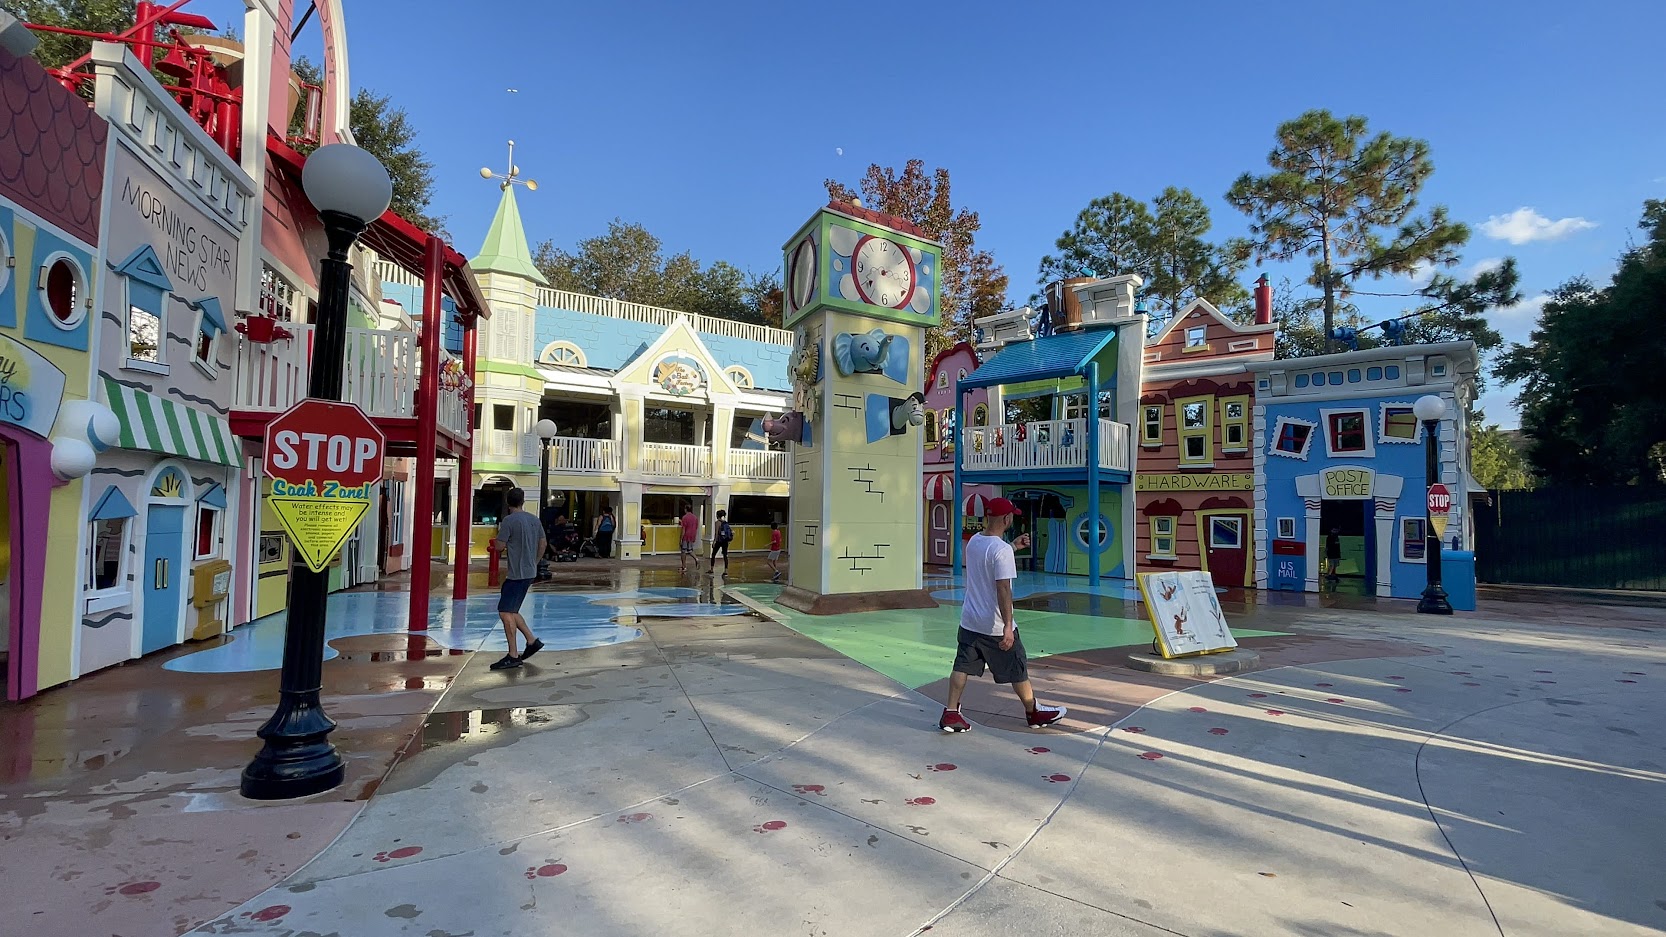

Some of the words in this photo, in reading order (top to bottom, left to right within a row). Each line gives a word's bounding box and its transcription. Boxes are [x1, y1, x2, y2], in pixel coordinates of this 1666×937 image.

[121, 176, 196, 254] MORNING
[198, 234, 232, 280] STAR
[880, 242, 888, 252] 12
[166, 241, 207, 292] NEWS
[857, 261, 864, 273] 9
[903, 271, 909, 282] 3
[881, 293, 888, 306] 6
[273, 430, 378, 473] STOP
[1148, 474, 1240, 489] HARDWARE
[1325, 469, 1369, 485] POST
[272, 479, 316, 497] Soak
[323, 482, 371, 499] Zone!
[1325, 483, 1370, 496] OFFICE
[315, 503, 340, 511] effects
[1429, 494, 1450, 508] STOP
[1278, 569, 1298, 579] MAIL
